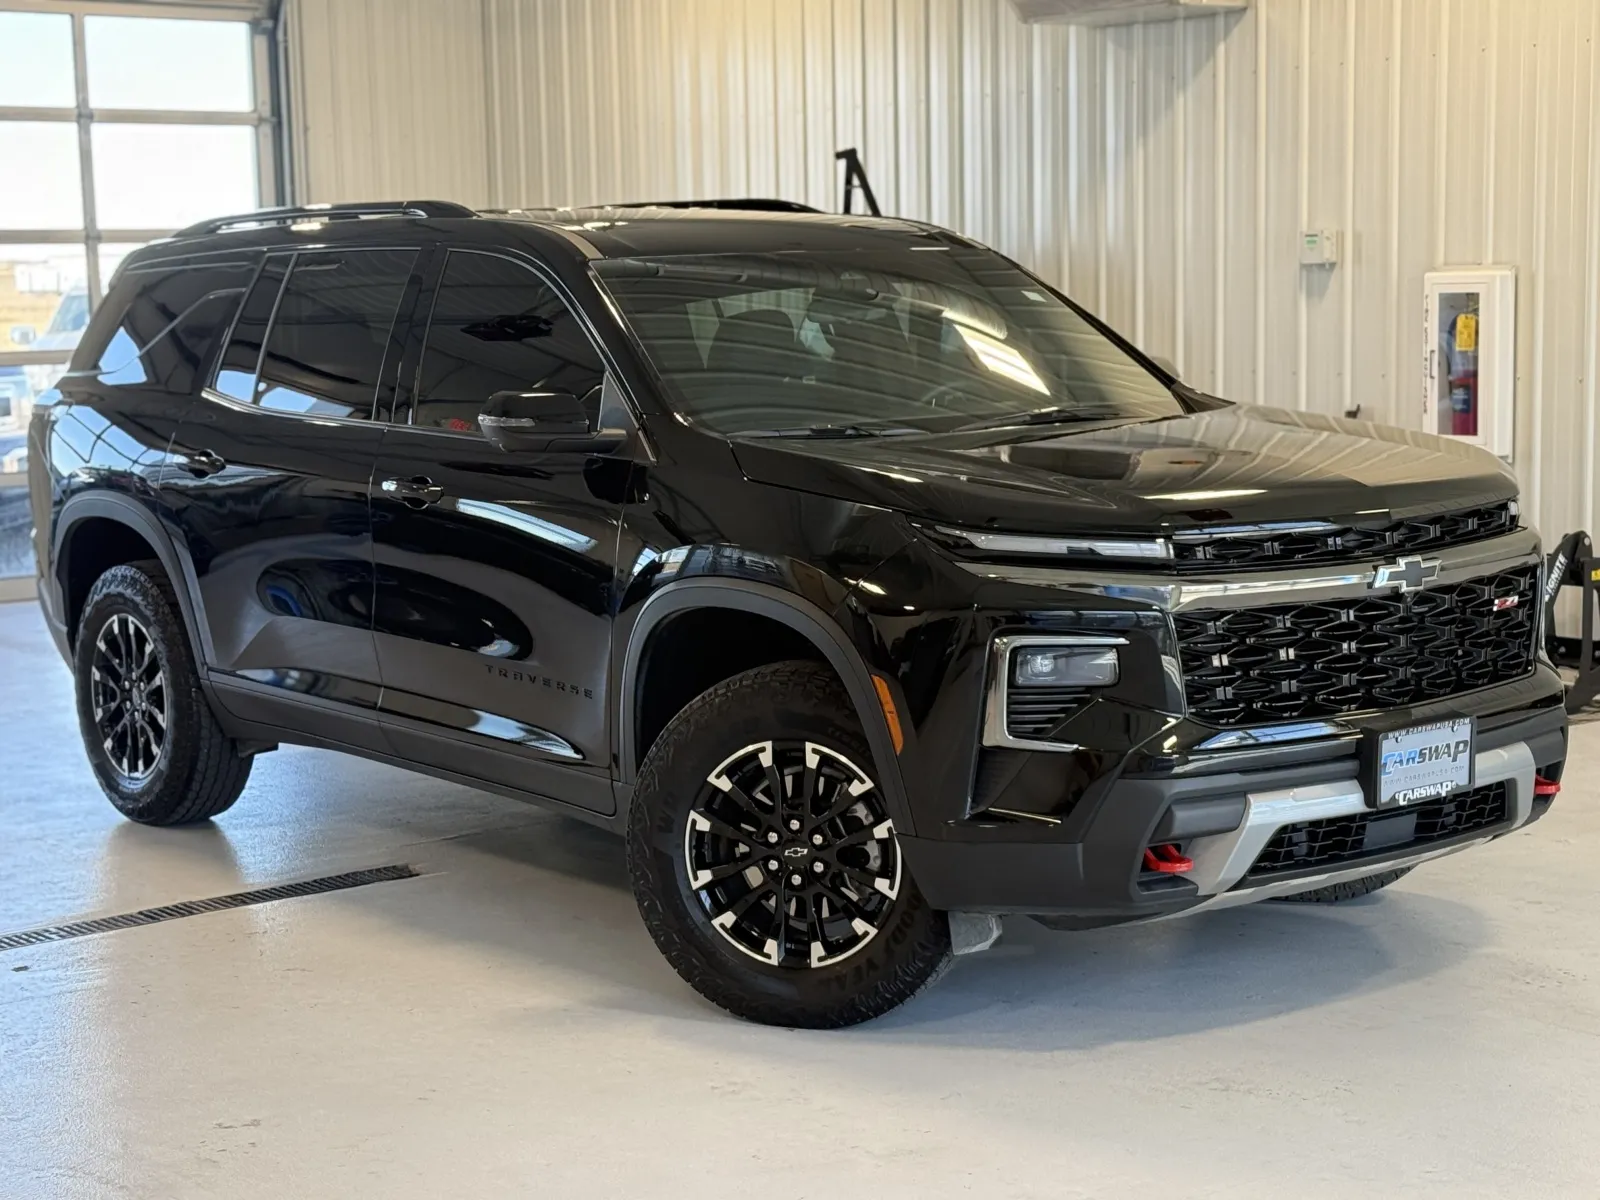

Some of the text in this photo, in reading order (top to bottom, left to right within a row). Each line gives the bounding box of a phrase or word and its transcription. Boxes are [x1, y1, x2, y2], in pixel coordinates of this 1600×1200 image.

[1546, 551, 1565, 594] IGNITE
[485, 664, 593, 700] TRAVERSE
[1388, 718, 1470, 739] WWW.CARSWAPUSA.COM
[1381, 740, 1469, 775] CARSWAP
[1399, 781, 1452, 806] CARSWAP
